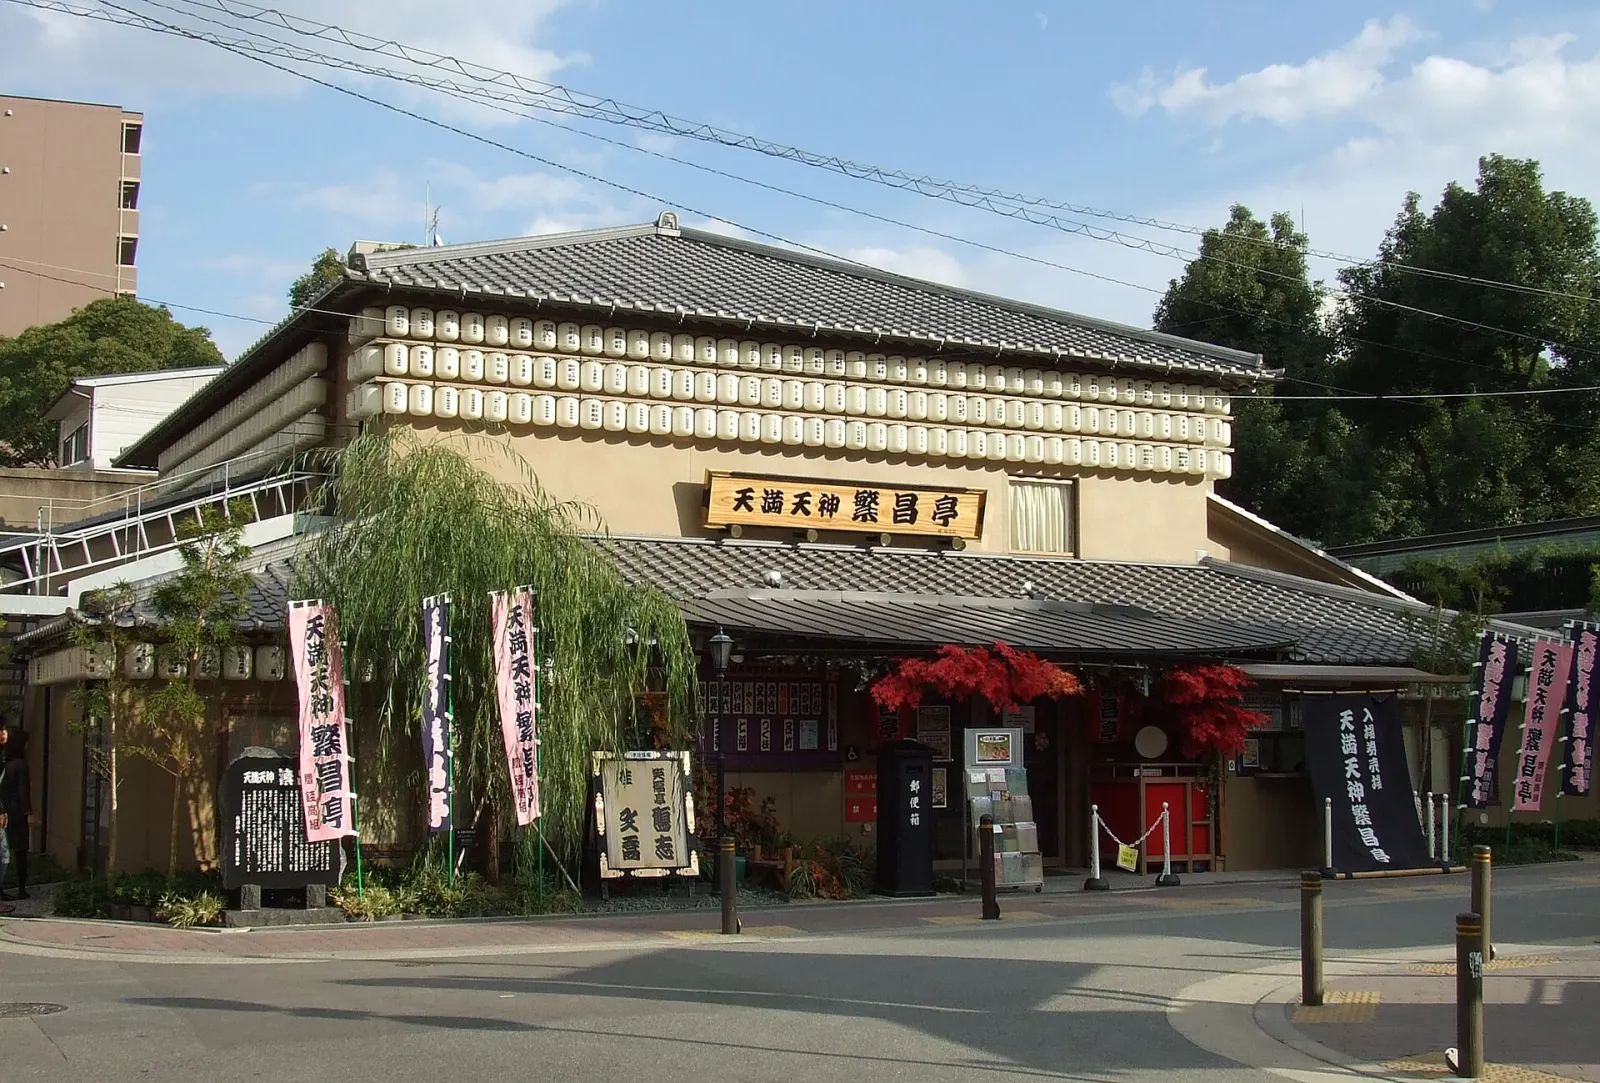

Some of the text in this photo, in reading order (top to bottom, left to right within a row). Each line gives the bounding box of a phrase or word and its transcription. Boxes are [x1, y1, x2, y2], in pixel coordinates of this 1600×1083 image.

[732, 486, 959, 527] 天満天神繁昌亭
[305, 614, 344, 830] 天満天神繁昌亭
[1338, 708, 1391, 864] 天満天神繁昌亭
[1518, 648, 1558, 804] 天満天神繁昌亭
[909, 779, 921, 827] 郵便箱
